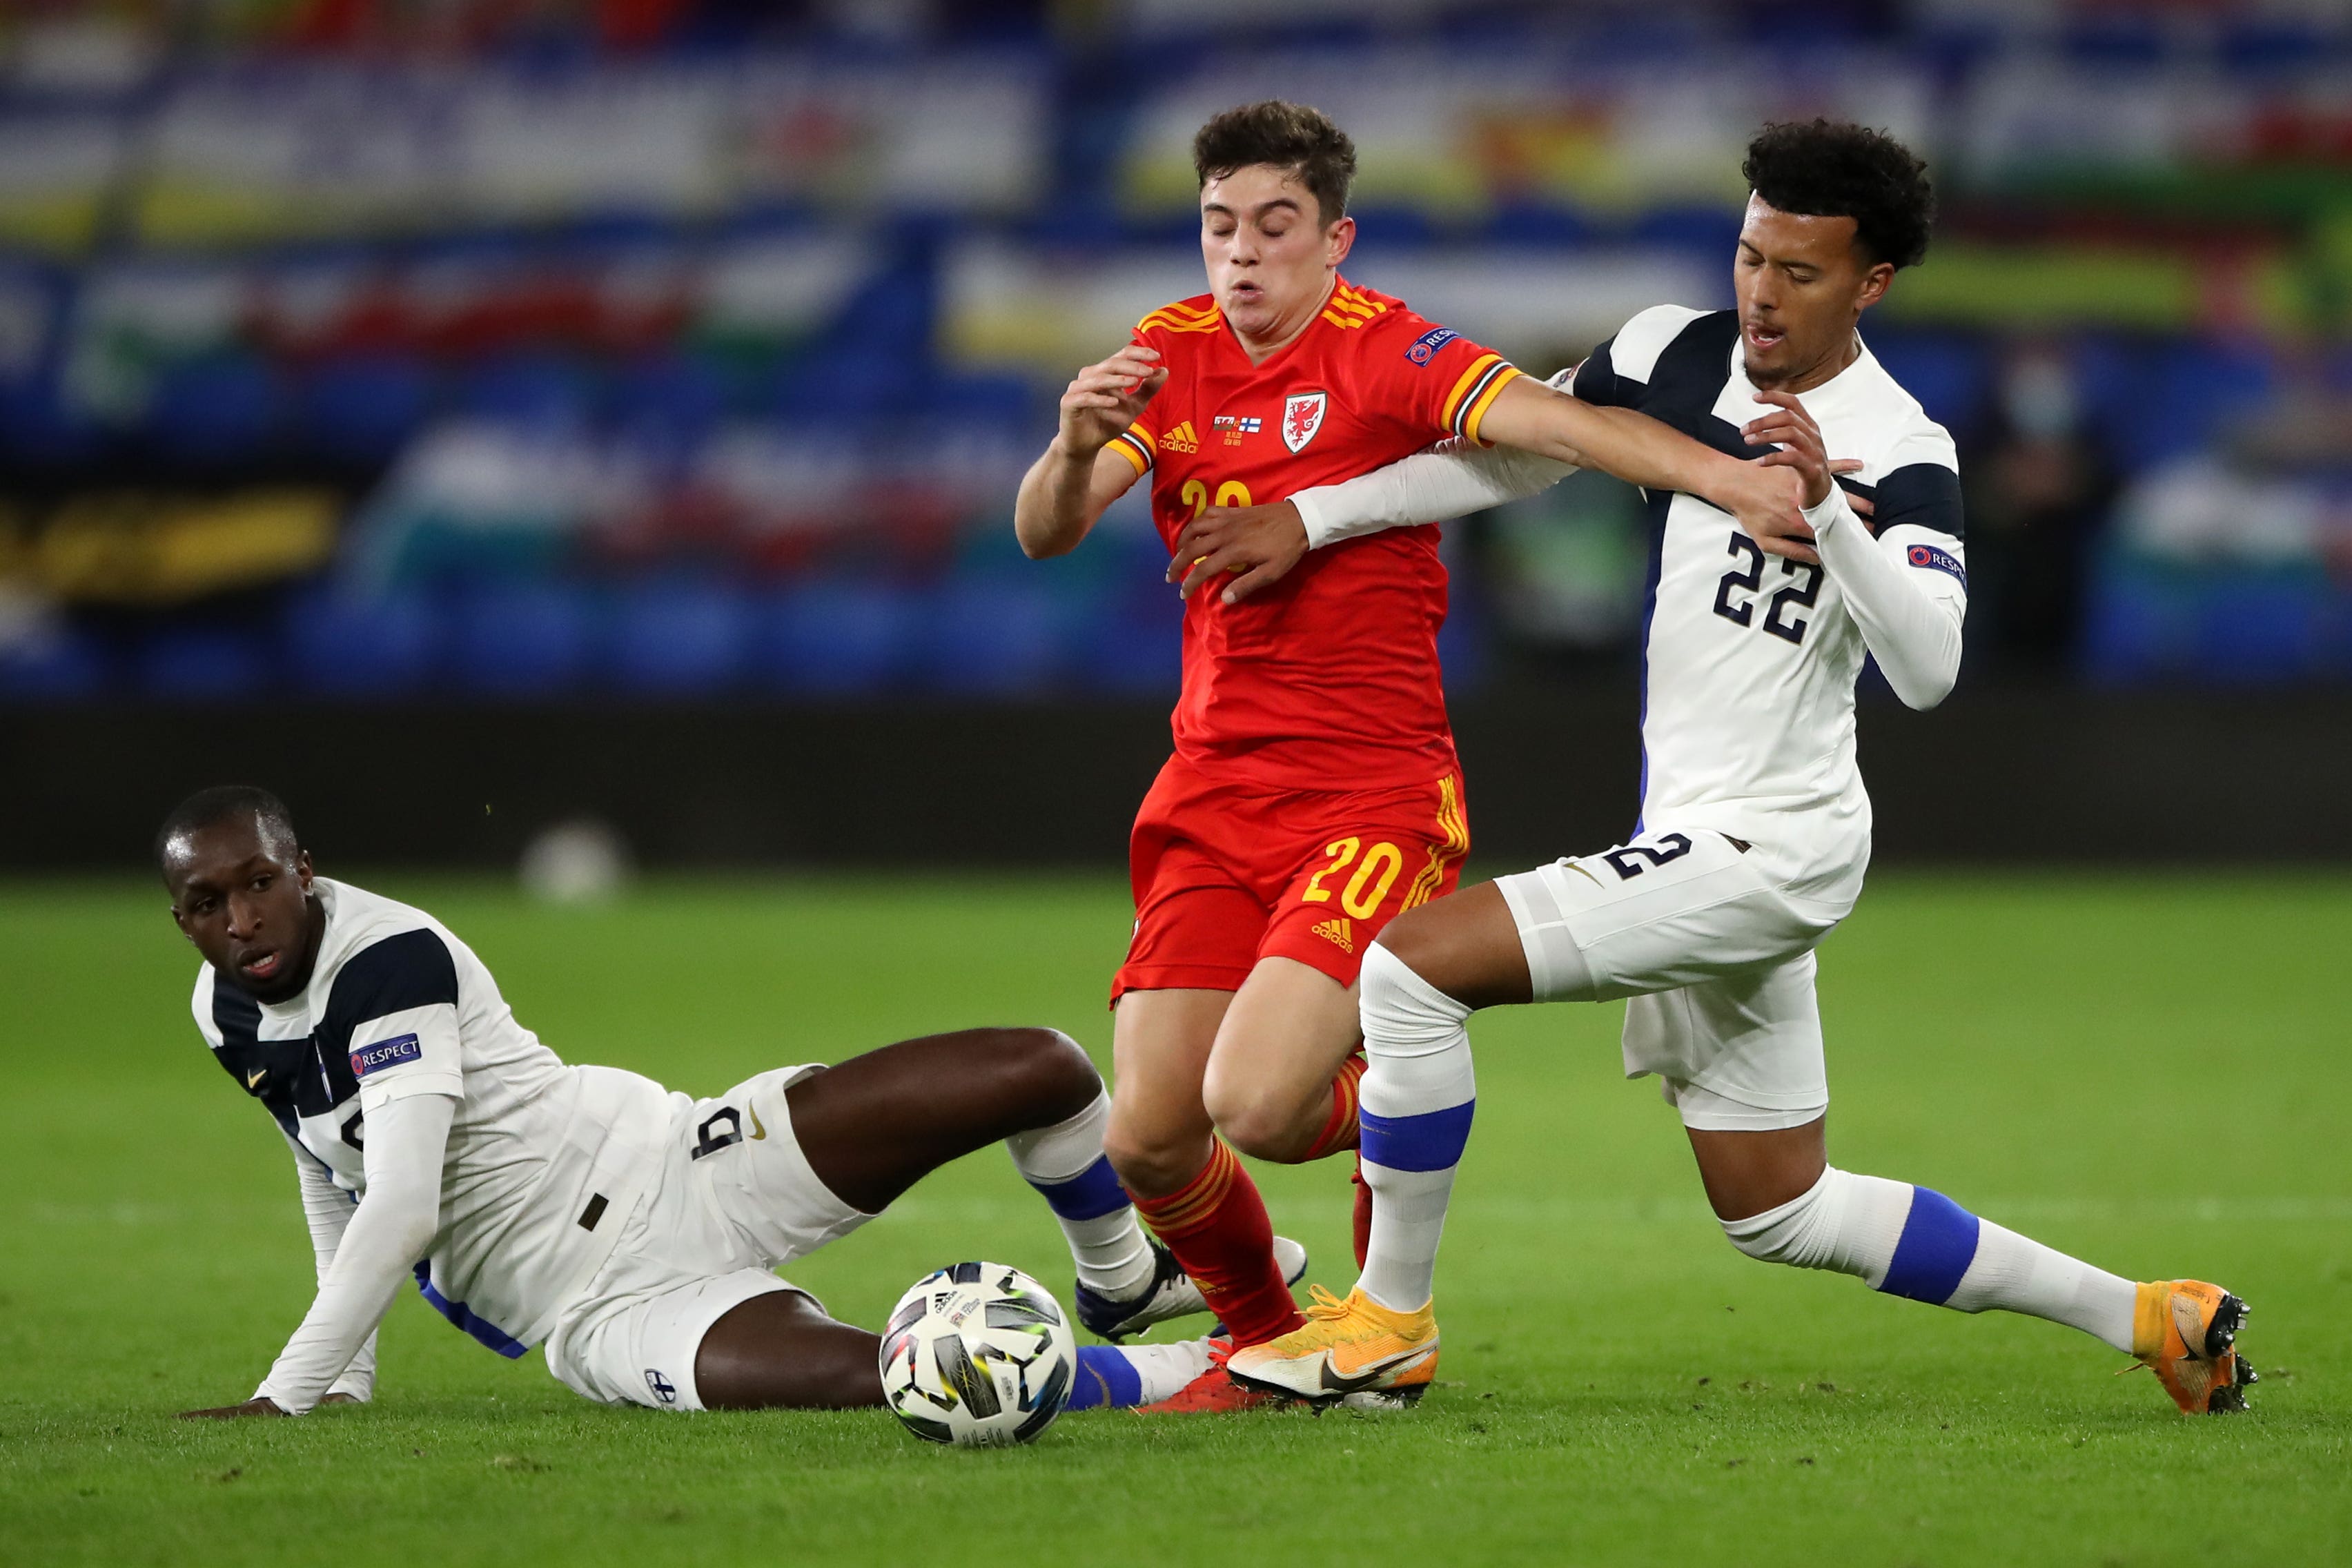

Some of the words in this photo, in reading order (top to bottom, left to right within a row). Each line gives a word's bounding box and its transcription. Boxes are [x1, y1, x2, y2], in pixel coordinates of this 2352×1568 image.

[1427, 330, 1454, 346] RES
[1714, 531, 1825, 647] 22
[1302, 836, 1402, 920] 20
[1311, 925, 1353, 954] adidas
[362, 1041, 418, 1067] RESPECT
